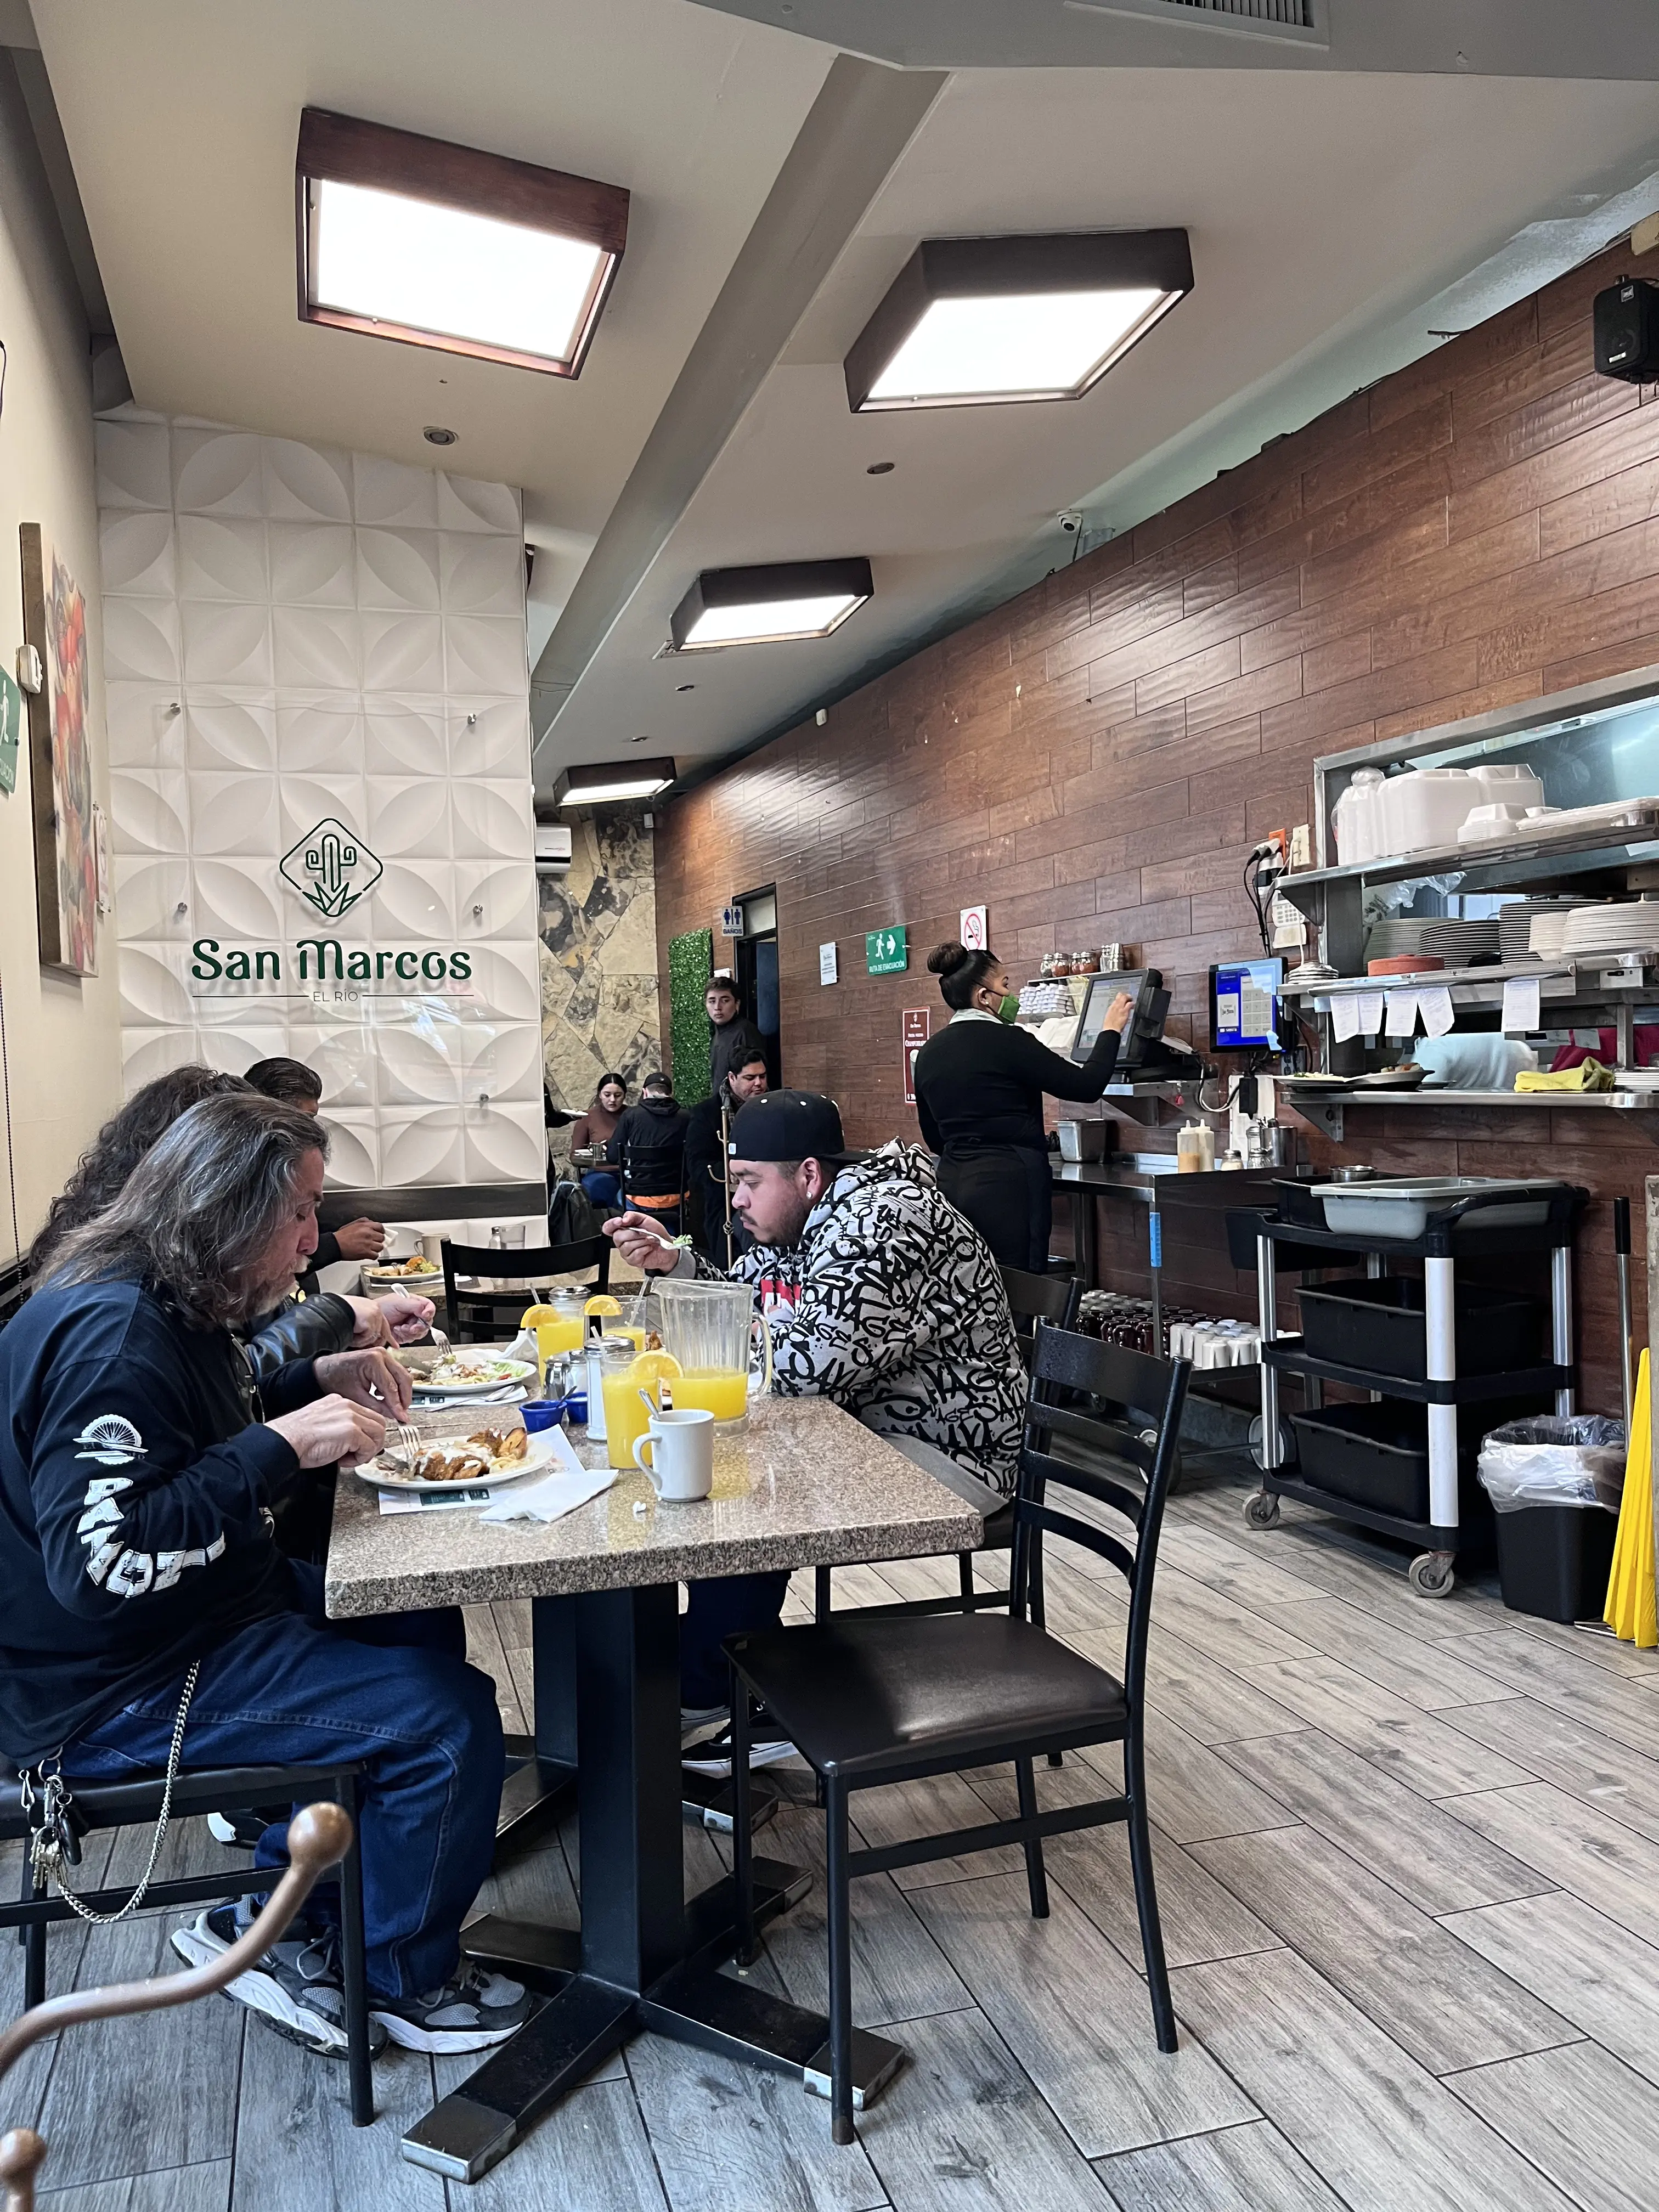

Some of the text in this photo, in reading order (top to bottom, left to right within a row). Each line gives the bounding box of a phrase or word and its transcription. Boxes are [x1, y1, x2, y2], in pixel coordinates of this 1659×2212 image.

[191, 939, 472, 980] San Marcos
[313, 988, 358, 1002] EL RÍO
